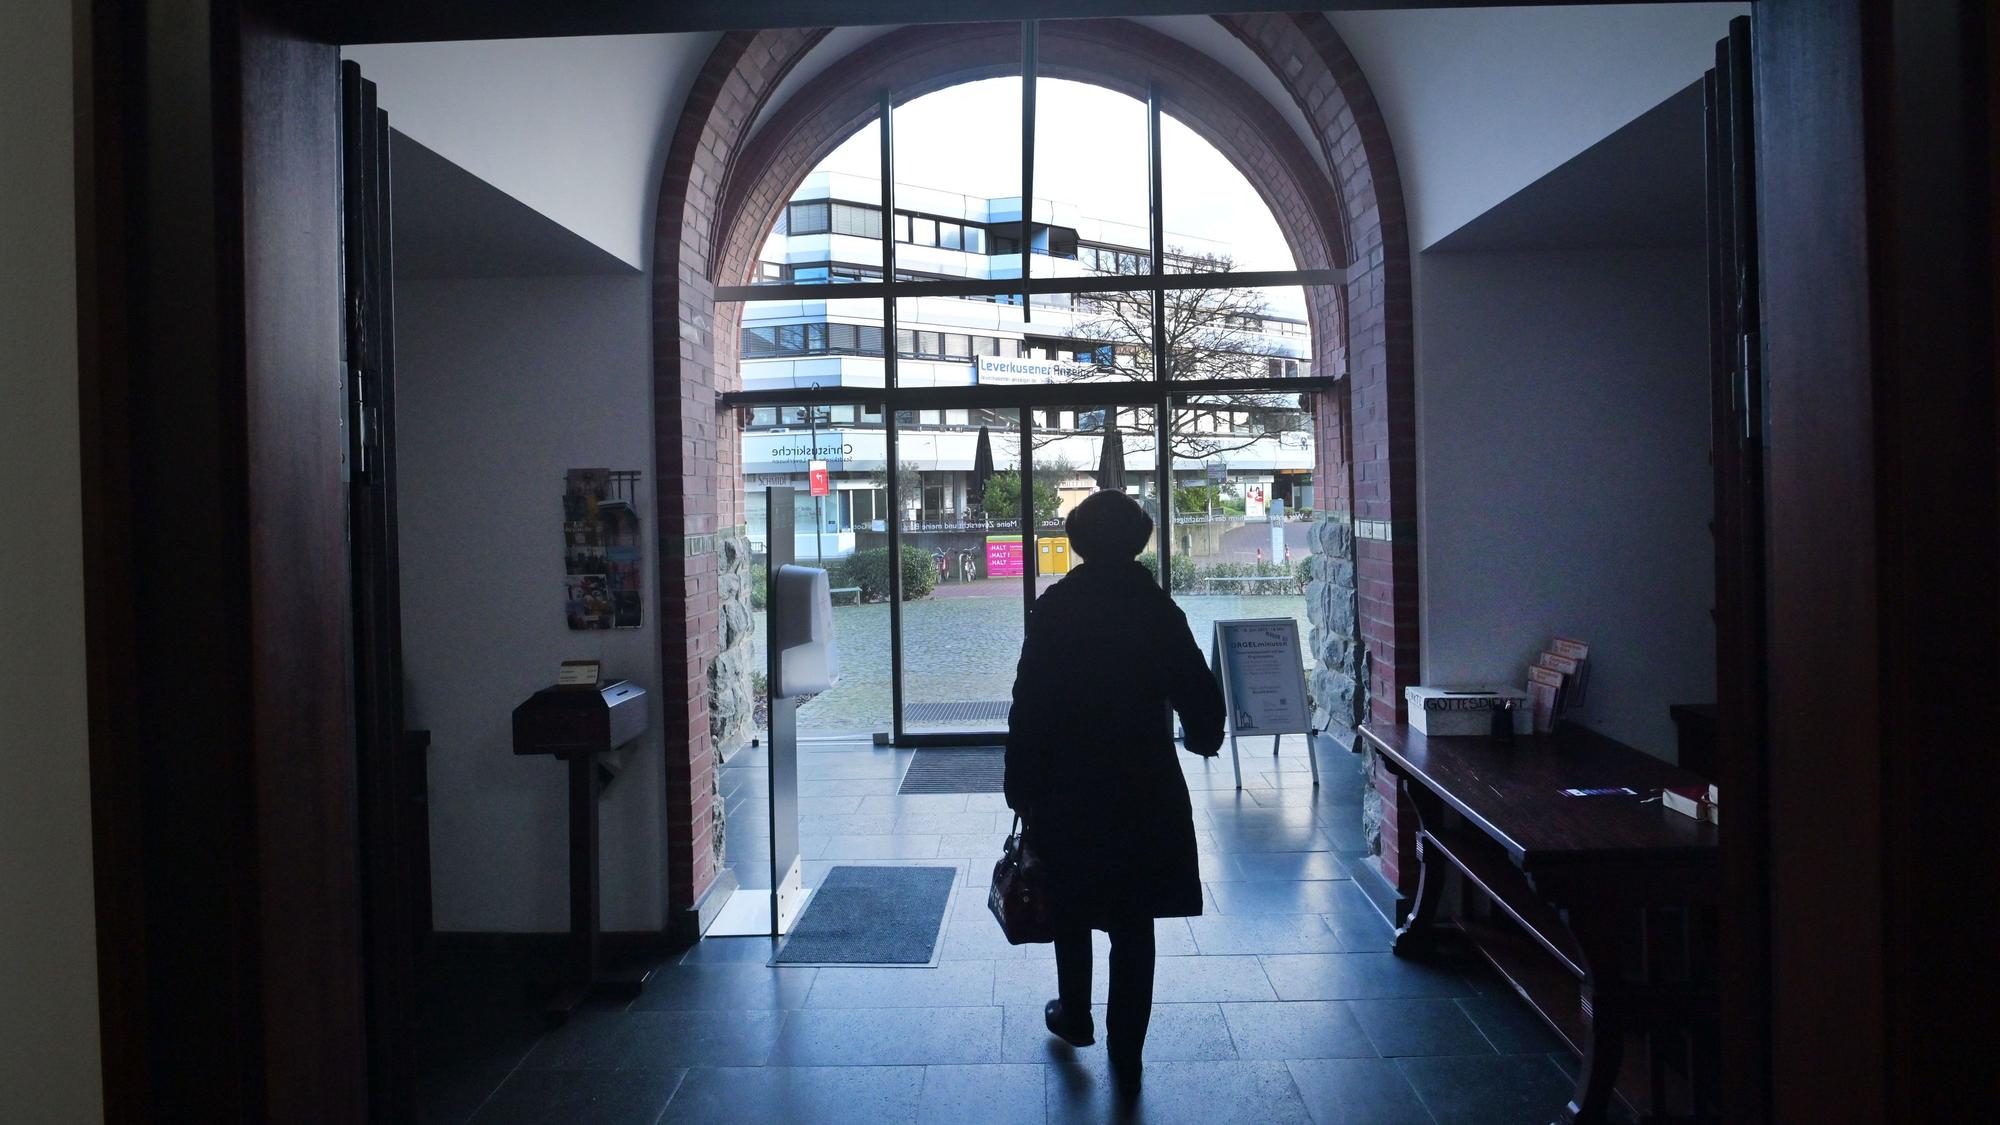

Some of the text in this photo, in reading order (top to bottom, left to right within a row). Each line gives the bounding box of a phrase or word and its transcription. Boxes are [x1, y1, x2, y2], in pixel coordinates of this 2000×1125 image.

[980, 359, 1052, 375] Leverkusener
[1053, 364, 1095, 379] Anzeig
[1424, 698, 1526, 711] GOTTESDIEST
